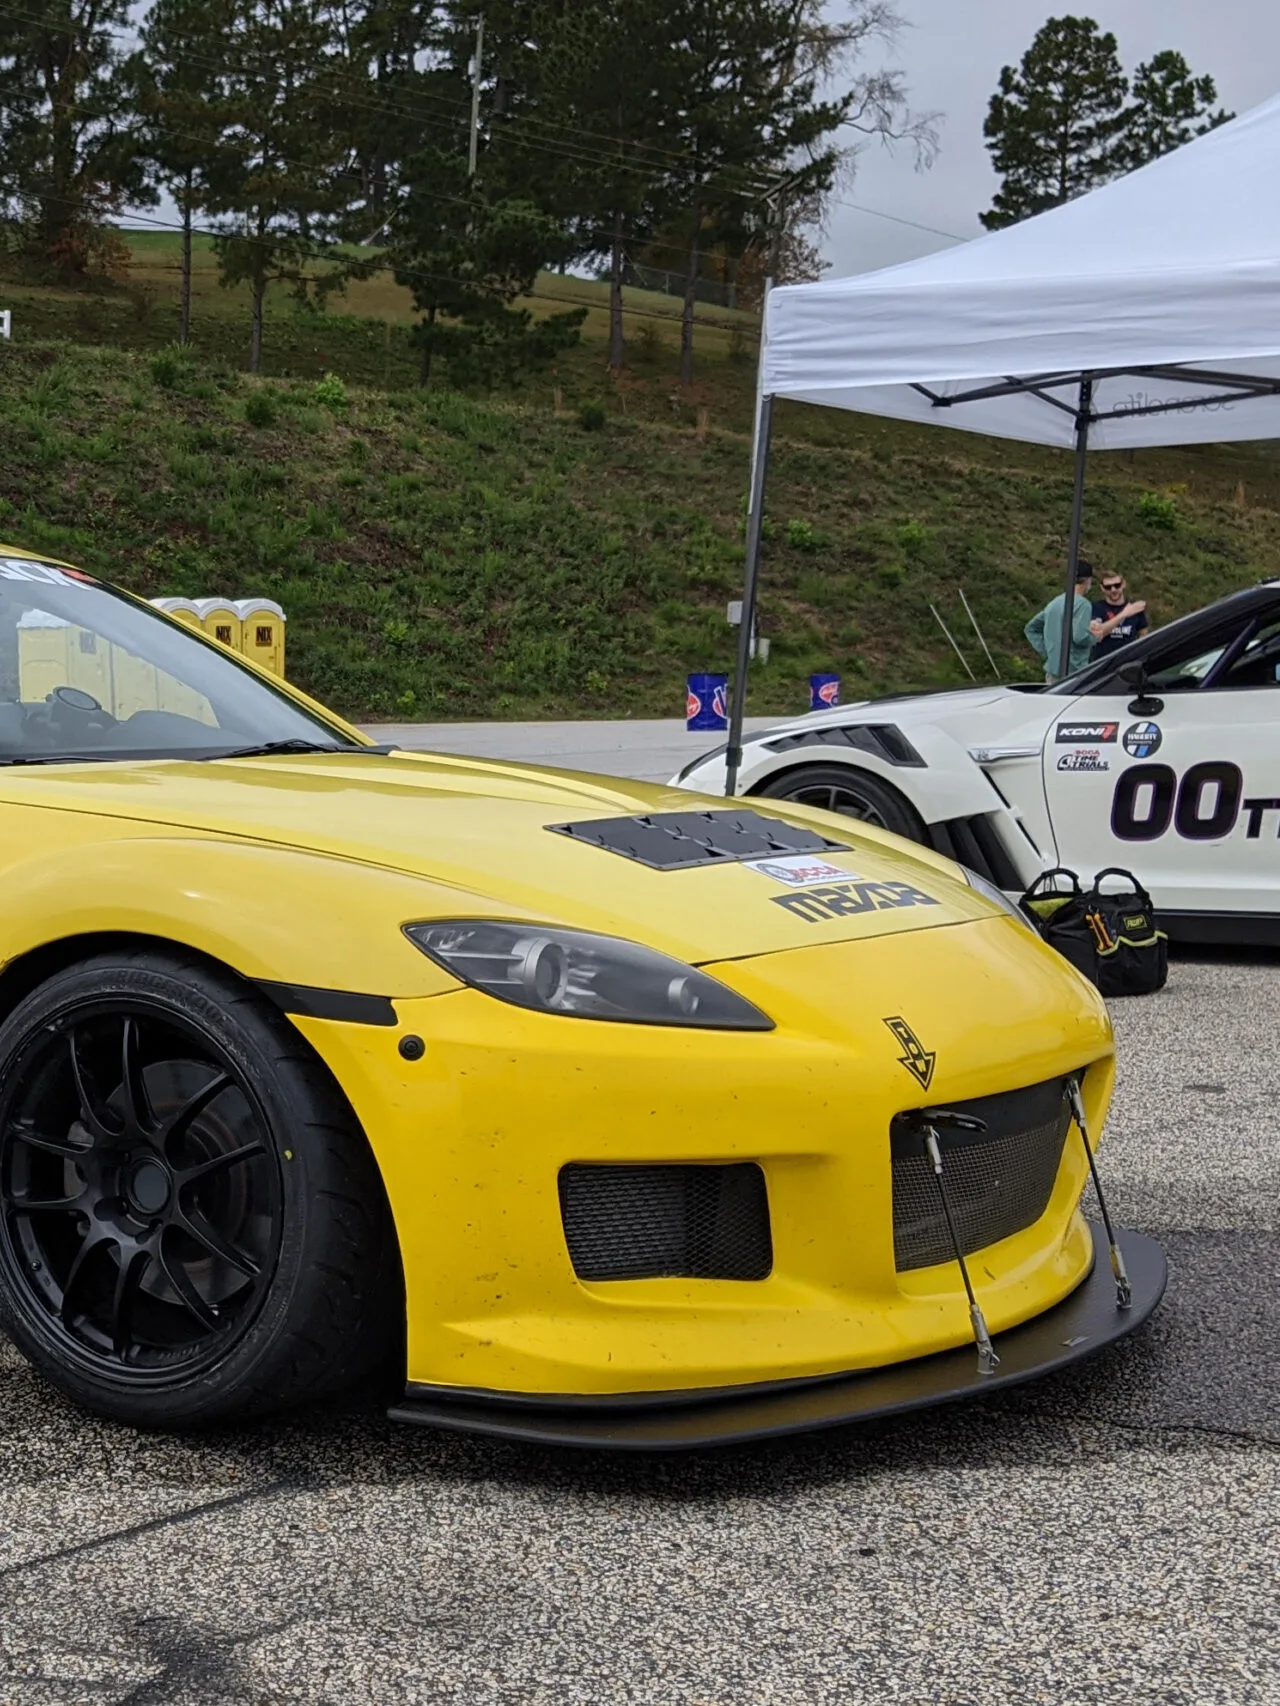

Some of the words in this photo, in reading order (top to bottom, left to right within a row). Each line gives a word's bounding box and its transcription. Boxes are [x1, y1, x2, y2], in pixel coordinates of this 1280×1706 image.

[1060, 727, 1105, 736] KONI
[1110, 760, 1244, 842] 00
[1242, 798, 1280, 839] T
[897, 1026, 928, 1073] TOW
